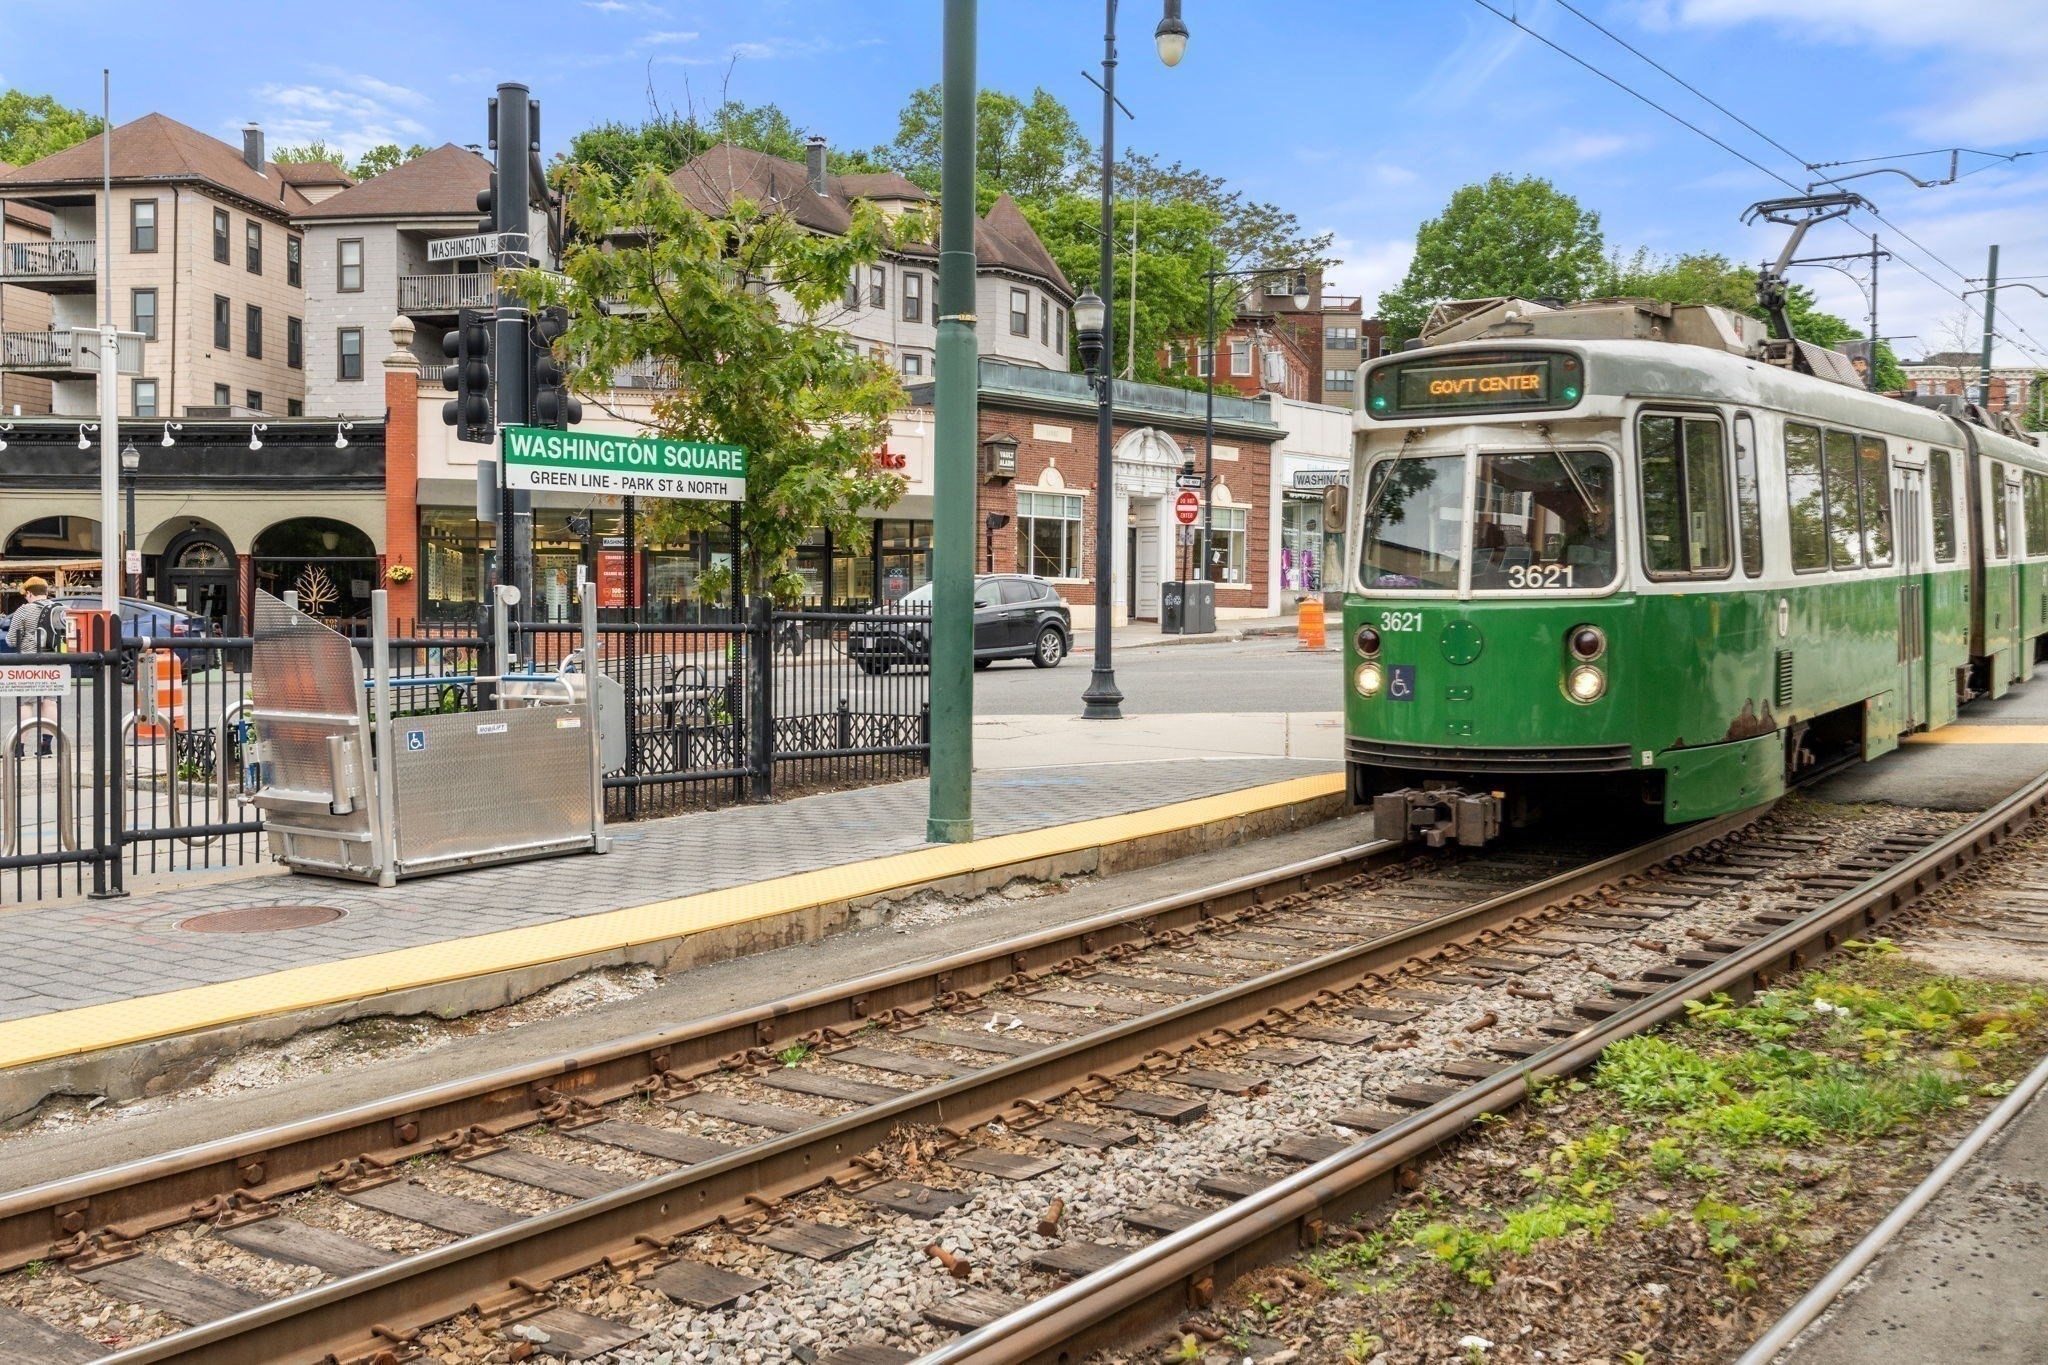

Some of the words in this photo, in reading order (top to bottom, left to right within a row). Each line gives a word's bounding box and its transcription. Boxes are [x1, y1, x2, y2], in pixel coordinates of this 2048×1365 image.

[431, 236, 487, 259] WASHINGTON
[1478, 374, 1540, 392] CENTER
[510, 433, 657, 466] WASHINGTON
[663, 445, 743, 471] SQUARE
[999, 450, 1015, 459] VAULT
[999, 459, 1015, 468] ALARM
[530, 470, 577, 487] GREEN
[581, 474, 609, 488] LINE
[621, 477, 654, 491] PARK
[658, 479, 673, 492] ST
[676, 480, 684, 493] &
[687, 480, 728, 495] NORTH
[1508, 565, 1574, 589] 3621
[1380, 611, 1422, 632] 3621
[7, 669, 61, 680] SMOKING
[479, 724, 505, 733] MOBILIFT
